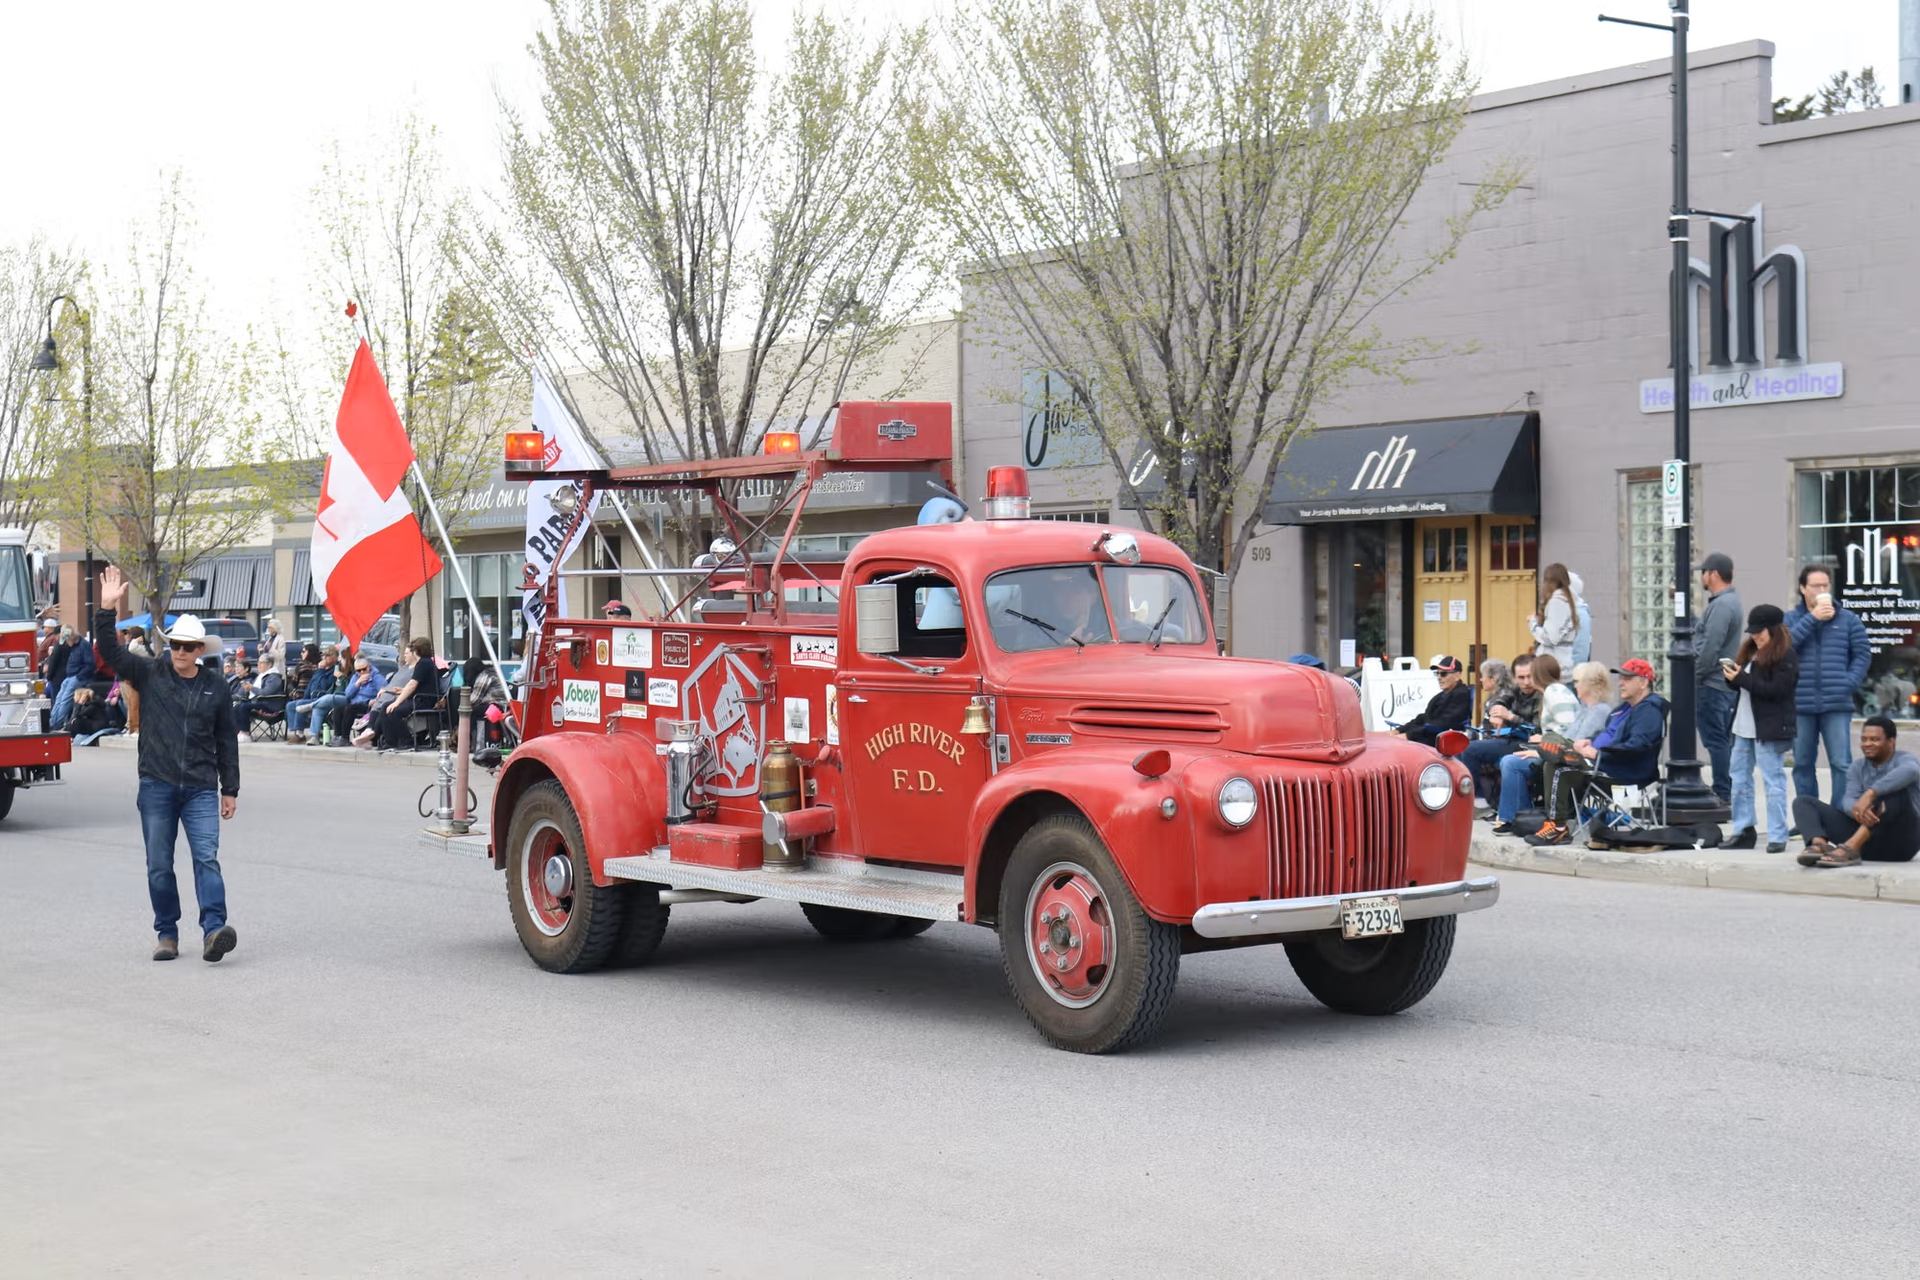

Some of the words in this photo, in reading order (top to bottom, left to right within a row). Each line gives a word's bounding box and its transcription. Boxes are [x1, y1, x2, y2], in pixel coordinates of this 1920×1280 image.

[1643, 380, 1708, 408] Heth
[1713, 372, 1750, 403] and
[1755, 372, 1839, 398] Healing
[1387, 504, 1407, 513] Health
[1420, 502, 1446, 512] Healing
[1252, 546, 1271, 561] 509
[1841, 598, 1881, 609] Treasures
[1882, 597, 1895, 608] for
[864, 723, 906, 761] HIGH
[909, 722, 966, 766] RIVER
